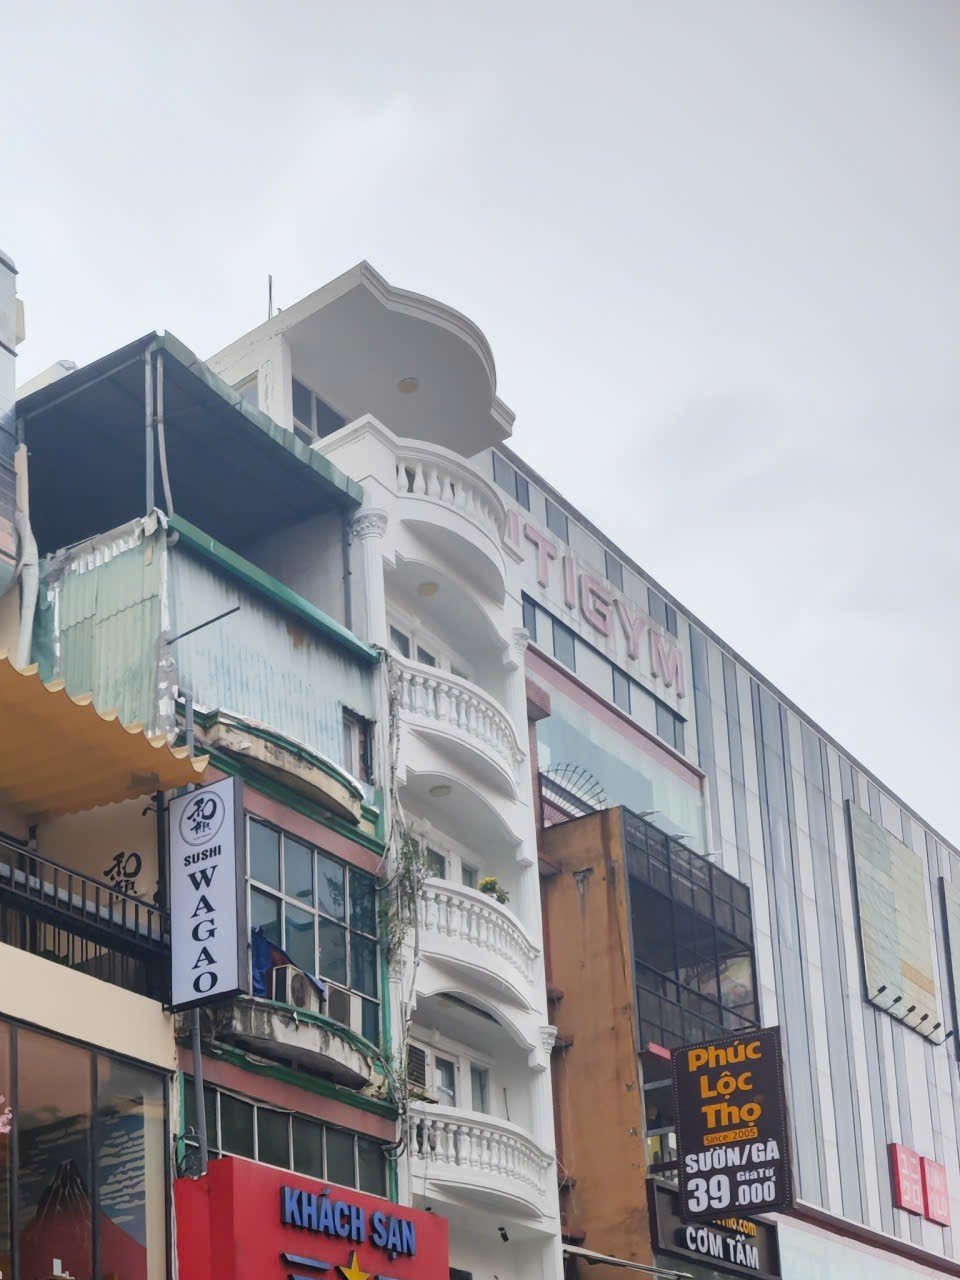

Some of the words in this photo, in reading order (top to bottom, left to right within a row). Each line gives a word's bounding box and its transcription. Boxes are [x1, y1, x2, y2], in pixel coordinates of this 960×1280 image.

[183, 844, 222, 868] SUSHI
[188, 864, 219, 994] WAGAO
[687, 1039, 762, 1072] Phúc
[700, 1071, 752, 1100] Lộc
[701, 1102, 762, 1128] Thọ
[705, 1133, 728, 1145] Since
[732, 1127, 756, 1141] 2005
[685, 1138, 781, 1174] SƯỜN/GÀ
[687, 1174, 731, 1213] 39
[282, 1186, 366, 1243] KHÁCH
[371, 1210, 416, 1262] SẠN
[685, 1225, 723, 1259] CƠM
[726, 1234, 760, 1270] TẤM
